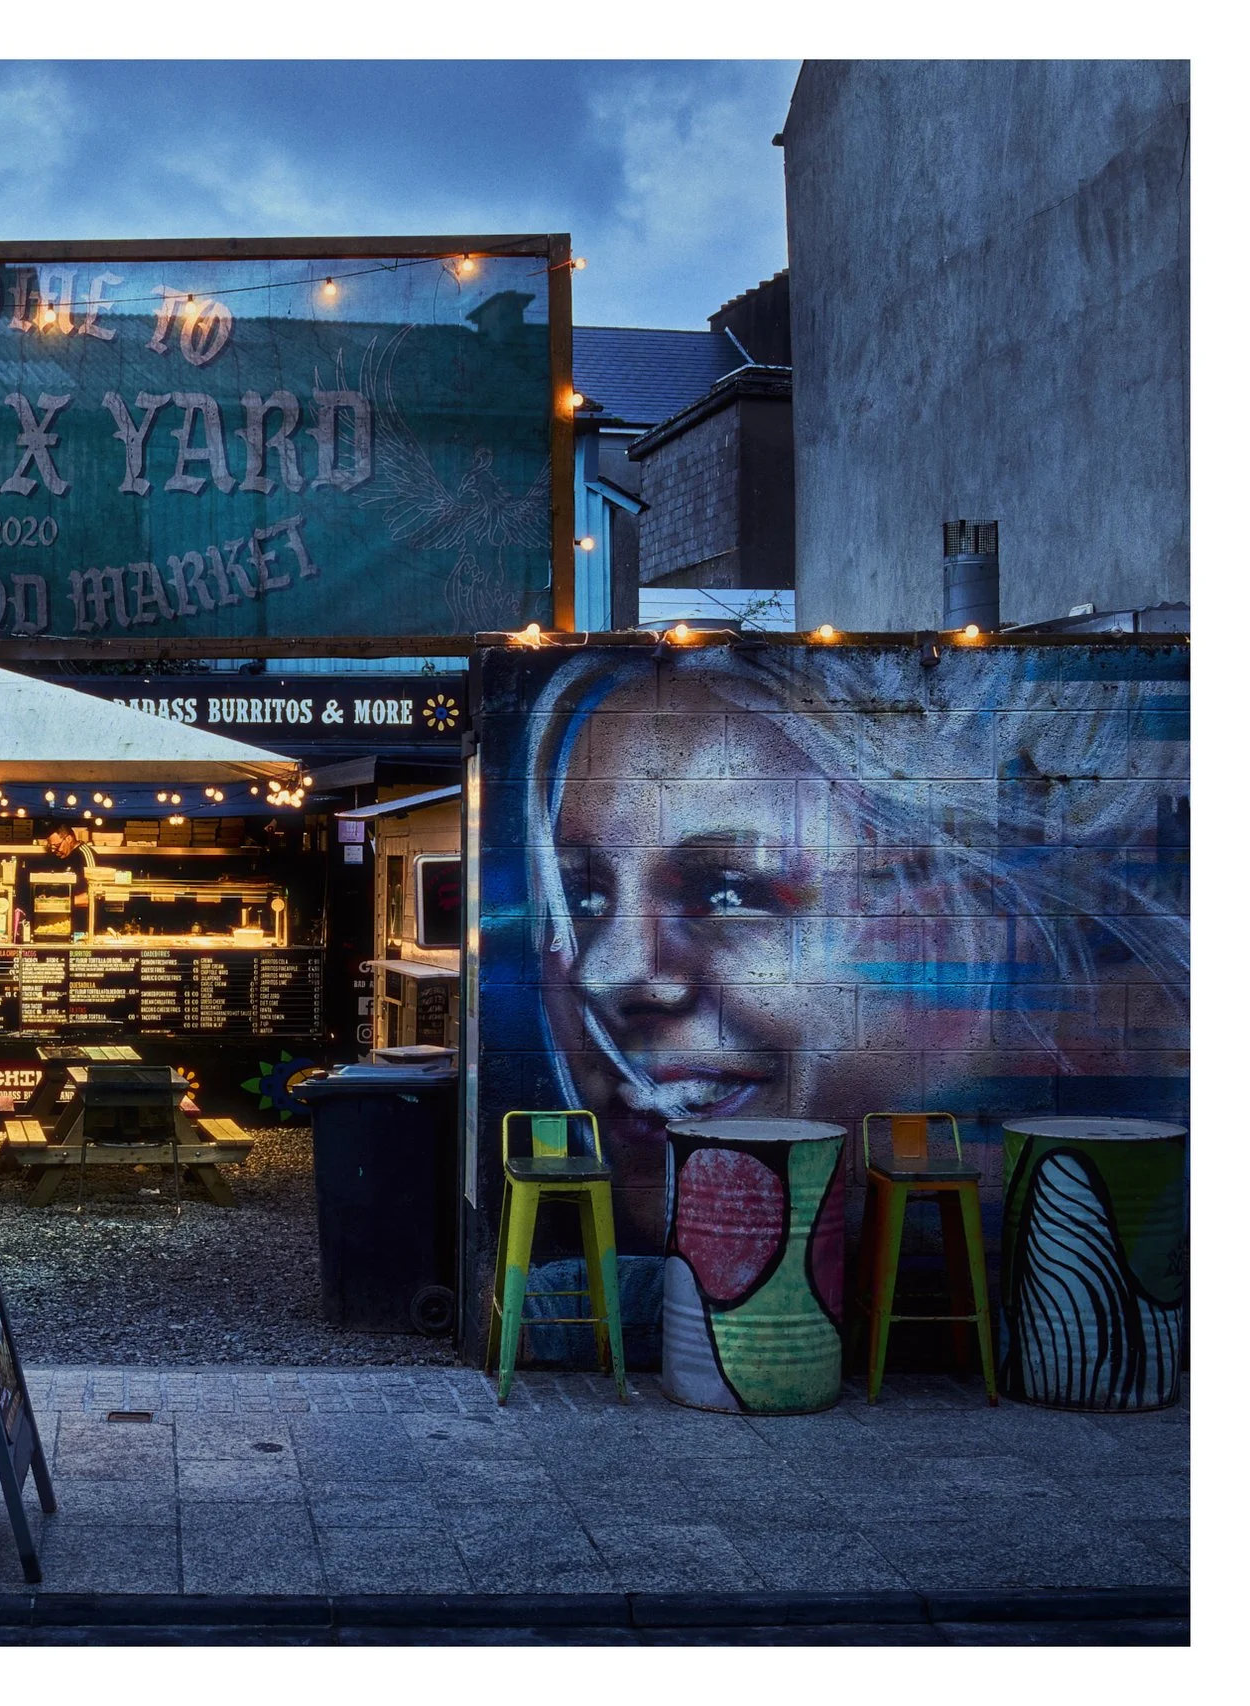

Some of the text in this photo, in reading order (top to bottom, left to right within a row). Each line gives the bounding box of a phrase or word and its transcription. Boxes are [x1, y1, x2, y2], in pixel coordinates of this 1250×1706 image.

[146, 284, 234, 367] TO
[102, 389, 375, 496] YARD
[66, 512, 320, 635] MARKET
[208, 698, 313, 724] BURRITOS
[321, 700, 344, 724] &
[354, 700, 413, 725] MORE
